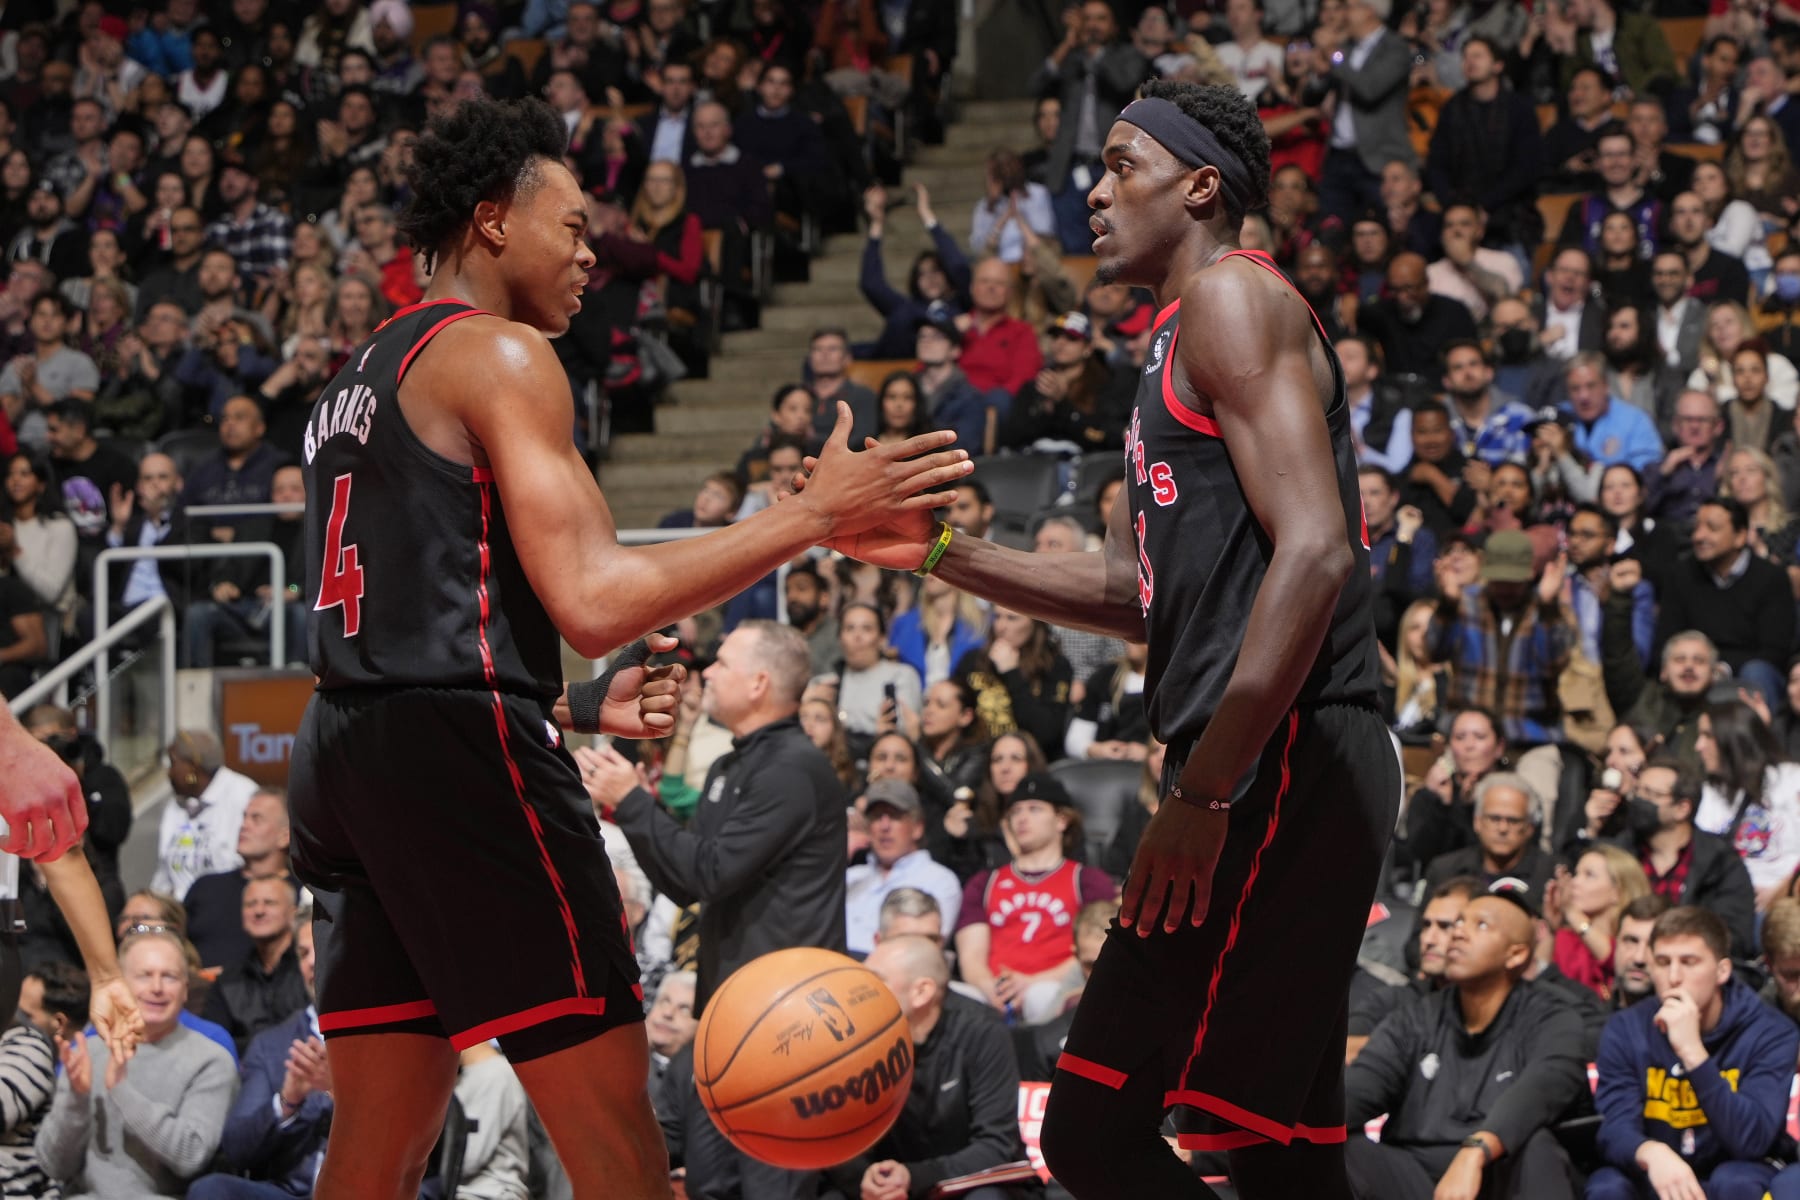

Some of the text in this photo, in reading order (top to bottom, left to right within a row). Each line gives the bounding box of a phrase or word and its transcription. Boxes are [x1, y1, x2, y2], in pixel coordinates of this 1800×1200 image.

[304, 384, 377, 466] BARNES
[313, 472, 364, 638] 4
[1020, 911, 1042, 943] 7
[789, 1037, 911, 1120] Wilson
